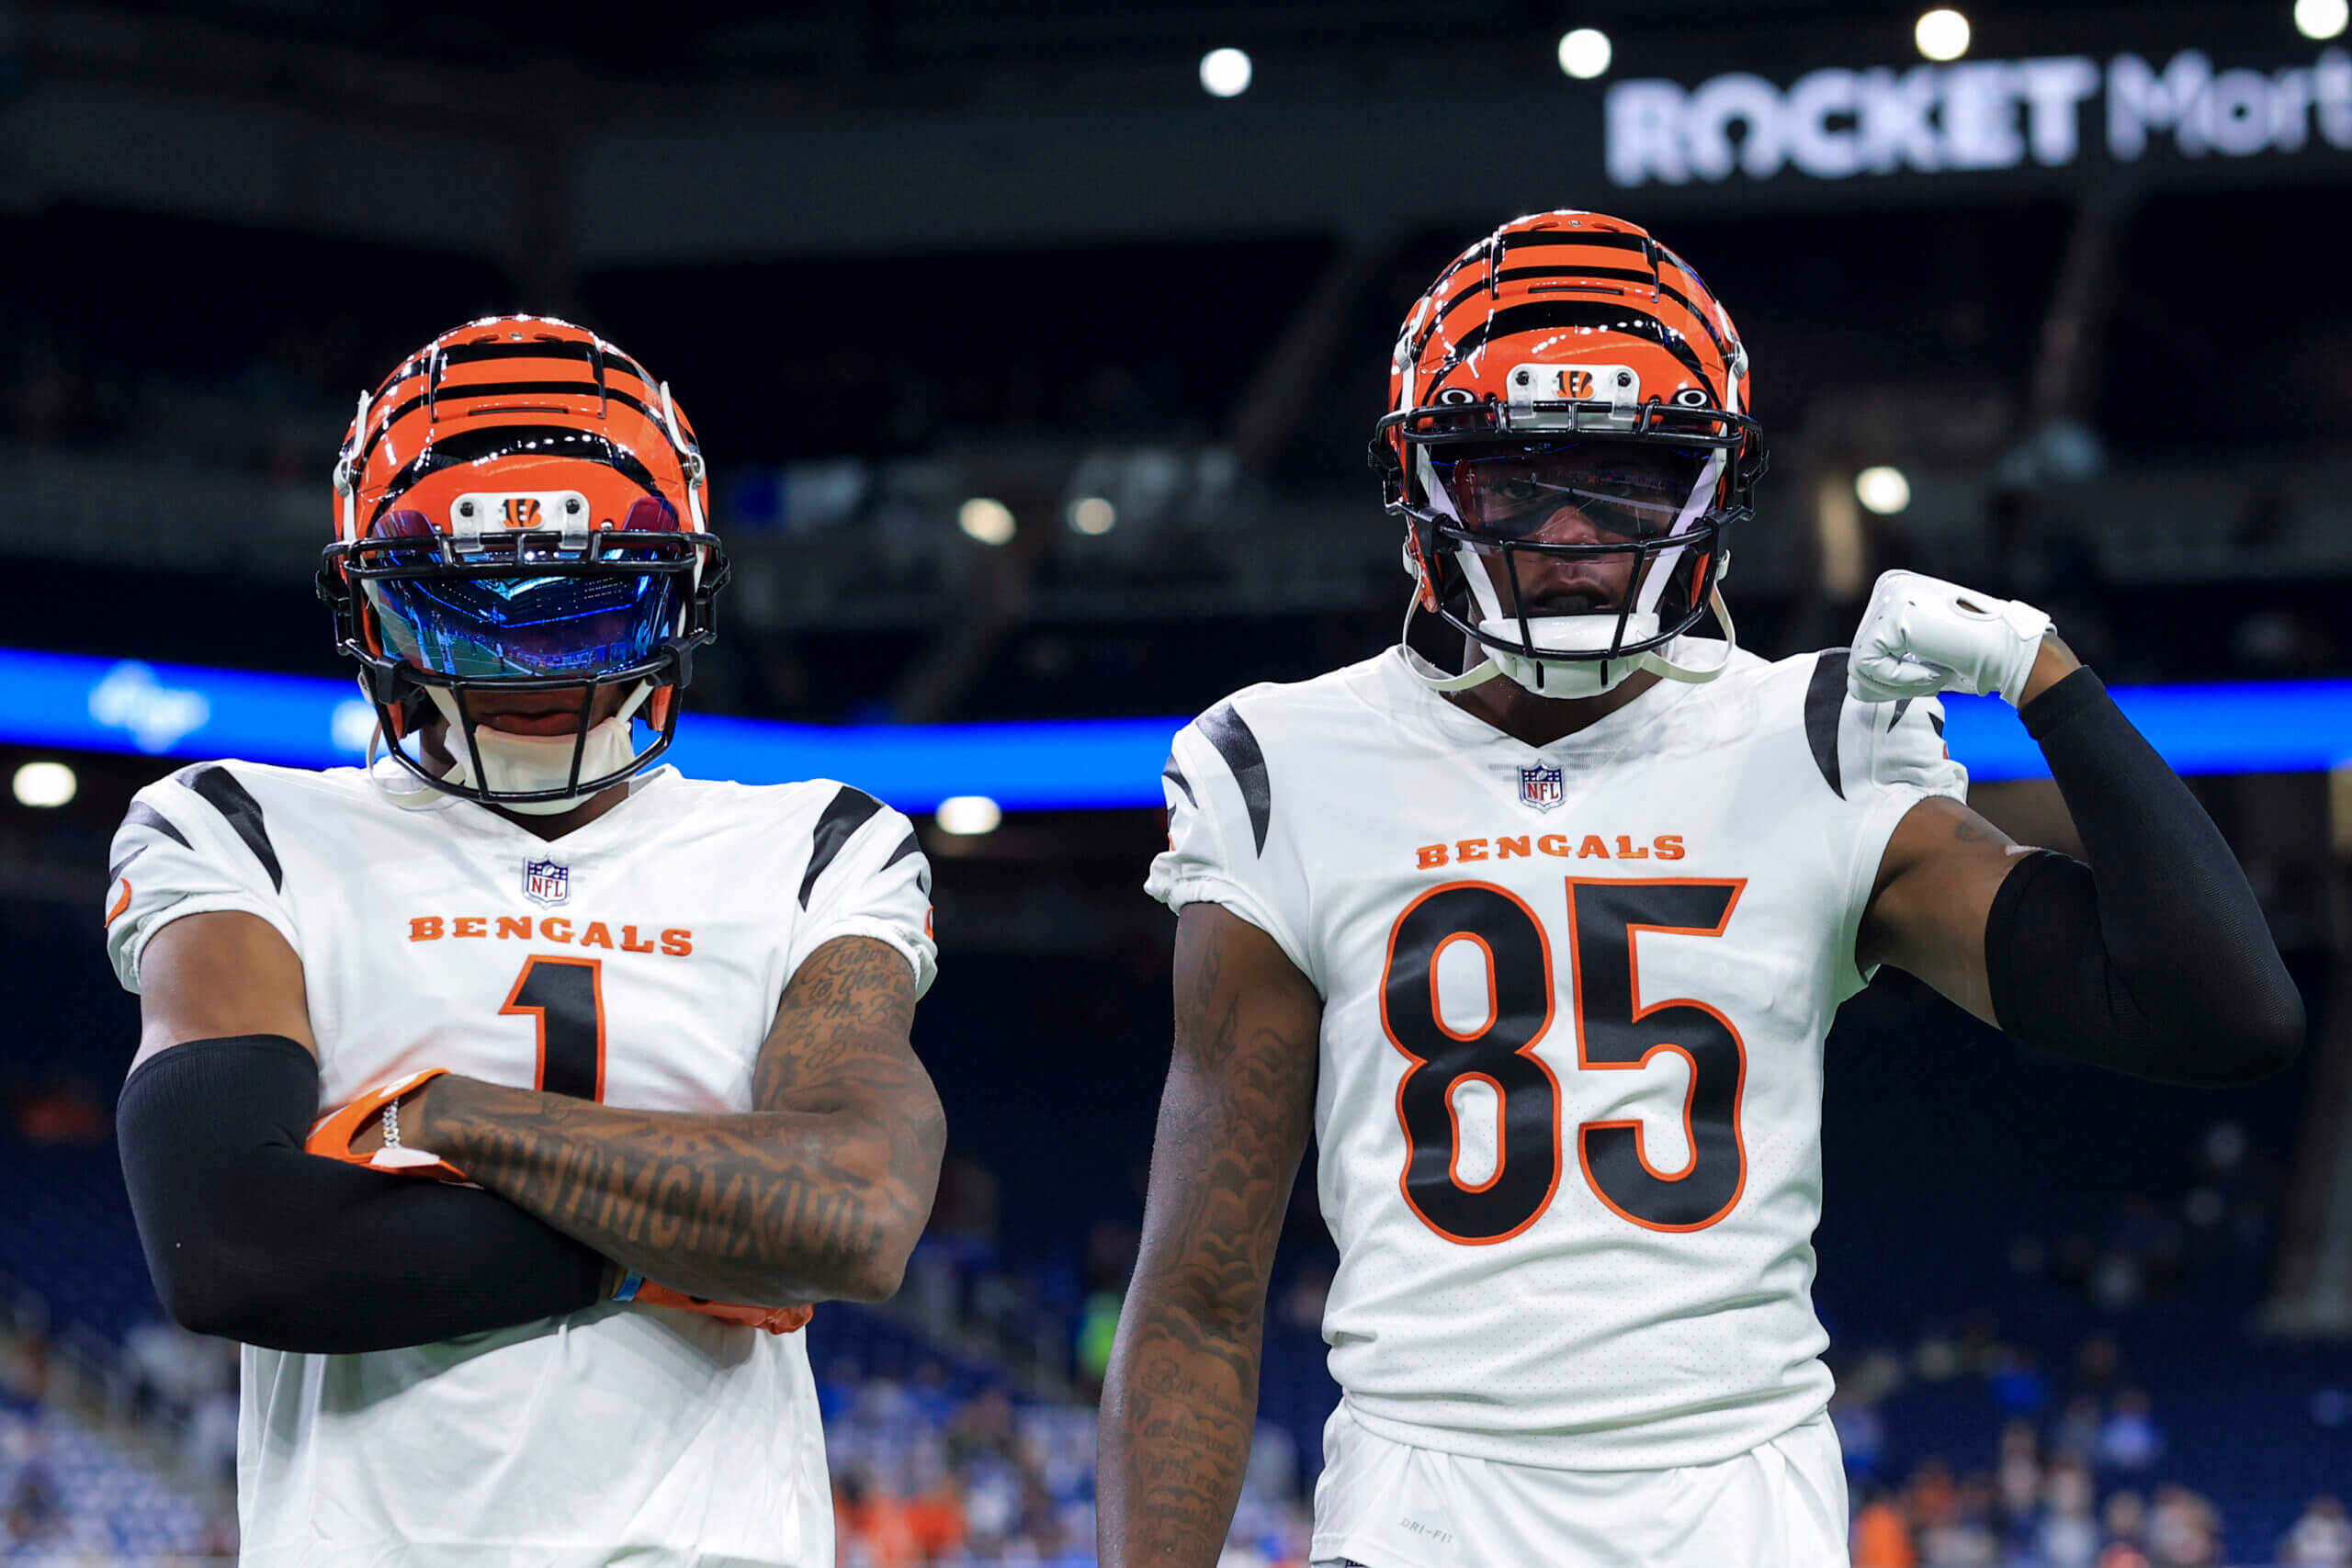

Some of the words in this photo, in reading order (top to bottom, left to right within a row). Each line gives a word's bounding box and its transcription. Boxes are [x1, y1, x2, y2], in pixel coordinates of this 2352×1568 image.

[1604, 57, 2100, 185] ROCKET
[1527, 783, 1559, 801] NFL
[1415, 834, 1686, 870] BENGALS
[531, 876, 563, 898] NFL
[409, 916, 693, 957] BENGALS
[497, 953, 606, 1105] 1
[1379, 875, 1748, 1247] 85
[1399, 1517, 1454, 1544] DRI-FIT
